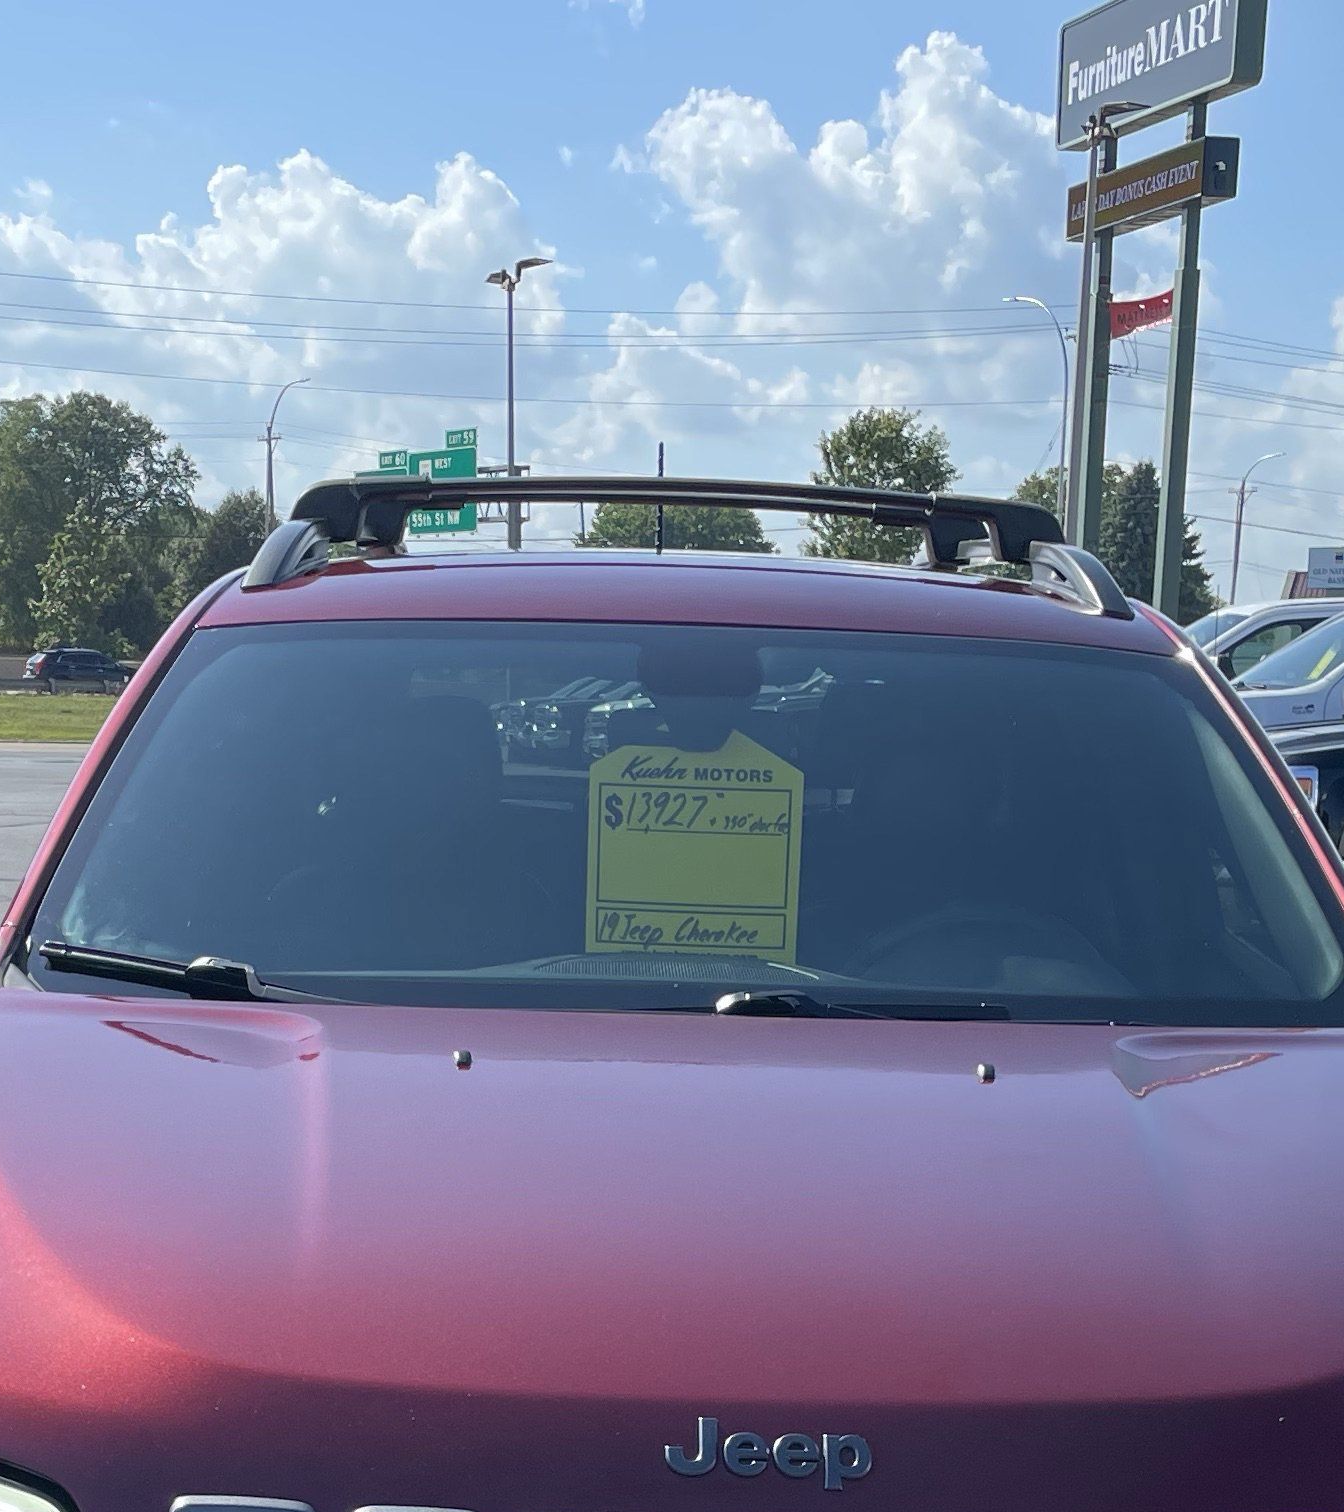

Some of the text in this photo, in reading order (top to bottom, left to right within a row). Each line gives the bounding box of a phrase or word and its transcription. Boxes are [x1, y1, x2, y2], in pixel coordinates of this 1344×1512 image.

[1098, 191, 1115, 211] DAY
[1115, 179, 1144, 206] BONUS
[1144, 171, 1167, 196] CASH
[1167, 160, 1199, 187] EVENT
[463, 430, 474, 444] 59
[394, 452, 406, 465] 60
[434, 457, 452, 469] WEST
[411, 512, 432, 527] 55th
[435, 512, 444, 526] St
[621, 756, 773, 783] Kuehn MOTORS
[600, 912, 759, 949] 19 Jeep Cherokee
[664, 1416, 872, 1491] Jeep
